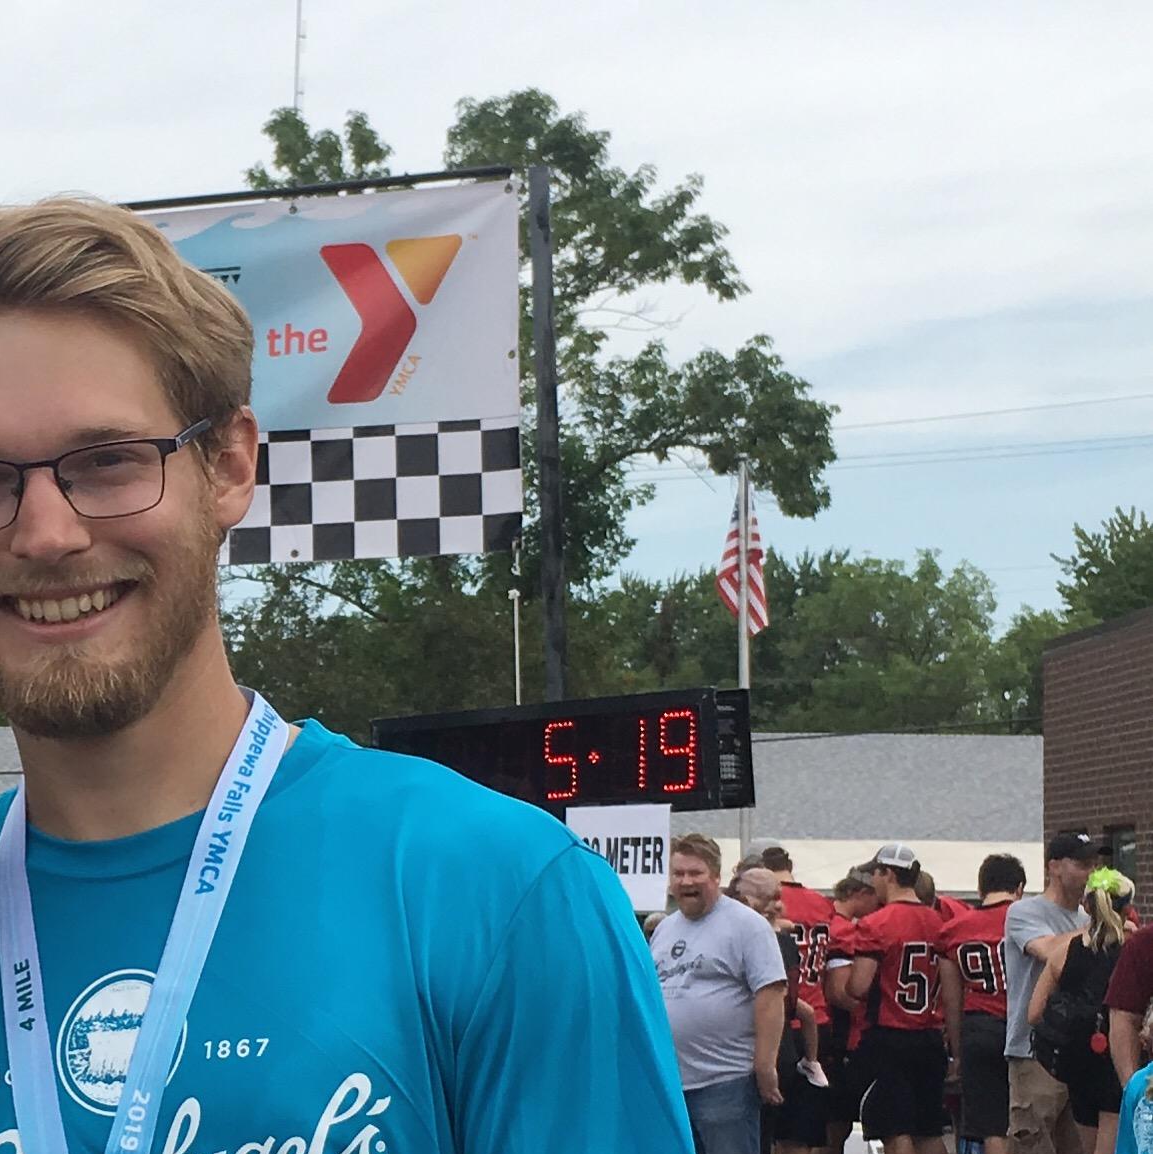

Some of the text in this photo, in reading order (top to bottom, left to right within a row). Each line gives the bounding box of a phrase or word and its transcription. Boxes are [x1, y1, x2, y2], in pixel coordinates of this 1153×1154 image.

[267, 323, 328, 357] the
[388, 354, 422, 397] YMCA
[217, 780, 251, 823] Falls
[194, 829, 233, 895] YMCA
[606, 836, 663, 874] METER
[956, 940, 1008, 995] 9
[13, 957, 34, 1032] 4 MILE
[203, 1037, 271, 1060] 1867
[119, 1088, 151, 1152] 2019
